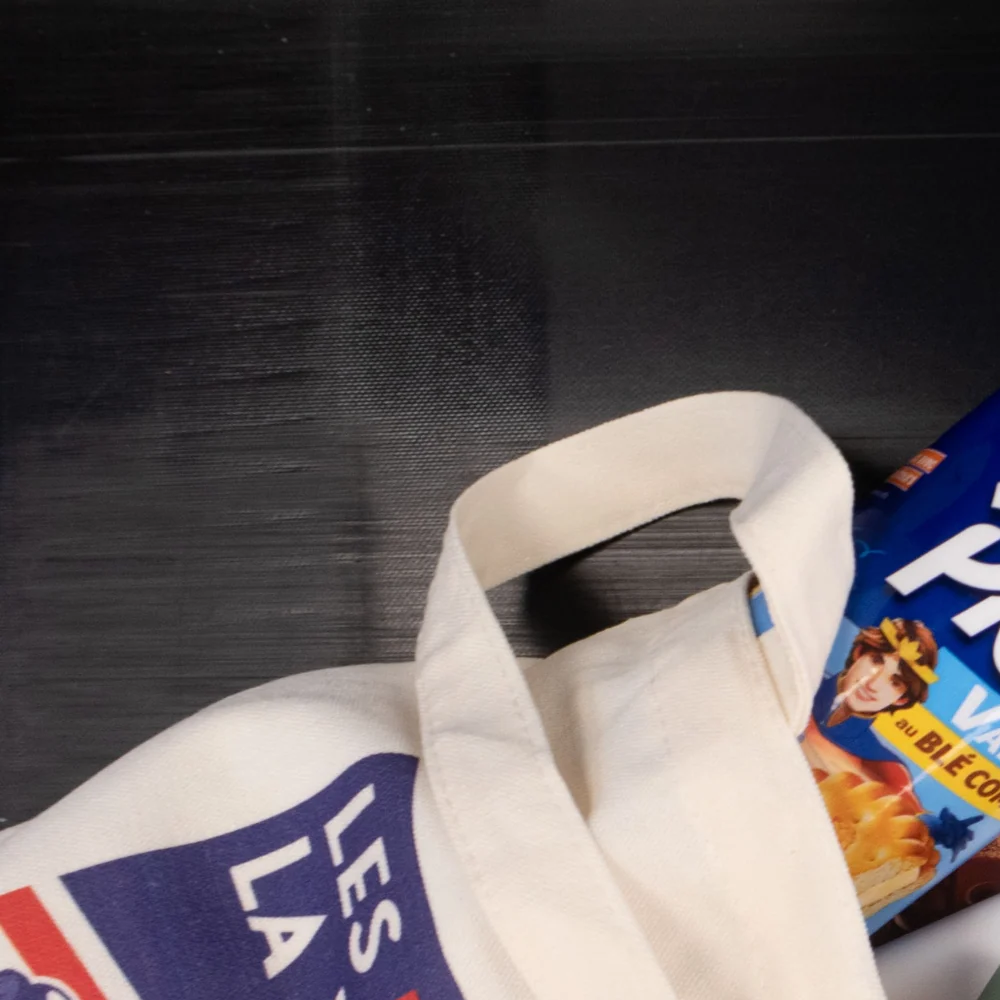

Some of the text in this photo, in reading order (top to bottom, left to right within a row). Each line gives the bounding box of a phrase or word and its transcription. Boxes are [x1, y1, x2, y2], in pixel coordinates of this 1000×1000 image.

[895, 717, 921, 738] au
[913, 730, 976, 779] BLÉ
[229, 835, 328, 981] LA
[323, 782, 401, 974] LES
